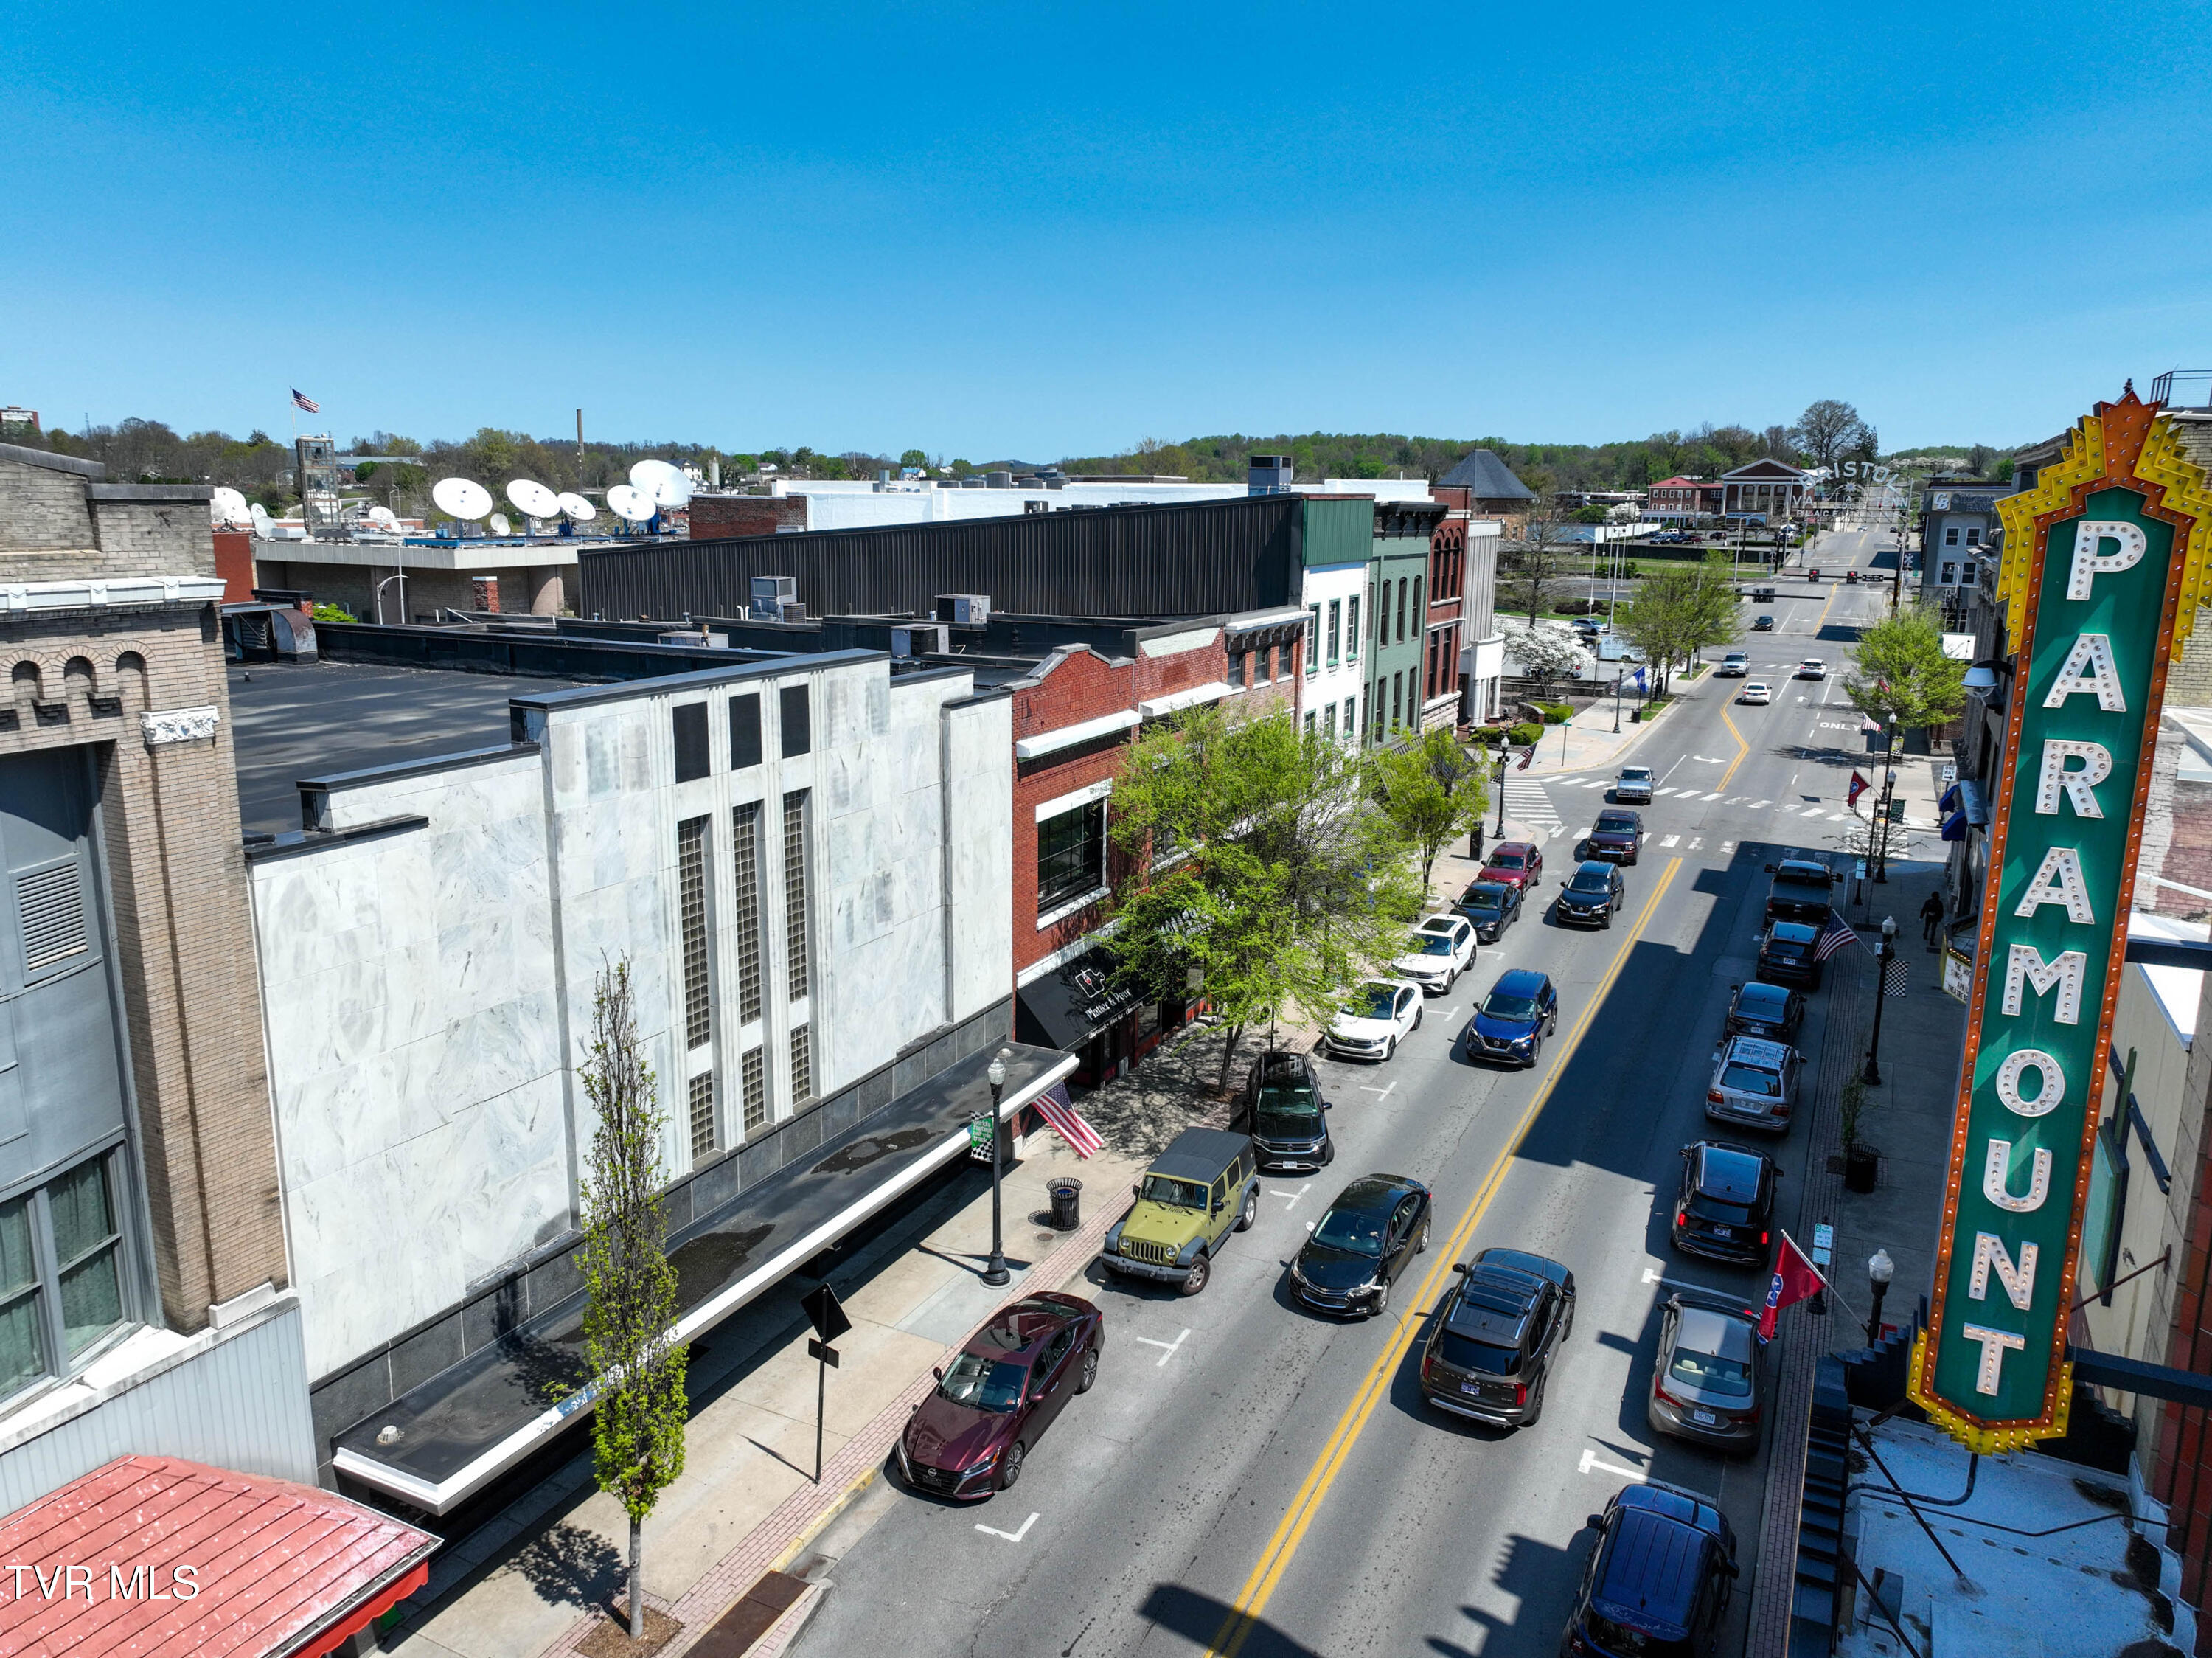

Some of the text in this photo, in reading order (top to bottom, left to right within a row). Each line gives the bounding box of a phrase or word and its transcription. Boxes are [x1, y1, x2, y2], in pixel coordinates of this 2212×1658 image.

[1798, 460, 1900, 496] BRISTOL
[1792, 495, 1813, 506] VA
[1820, 721, 1861, 732] ONLY
[1963, 521, 2147, 1396] PARAMOUNT
[1085, 1001, 1110, 1021] Platter
[1107, 996, 1117, 1006] &
[1113, 988, 1131, 1002] Pour
